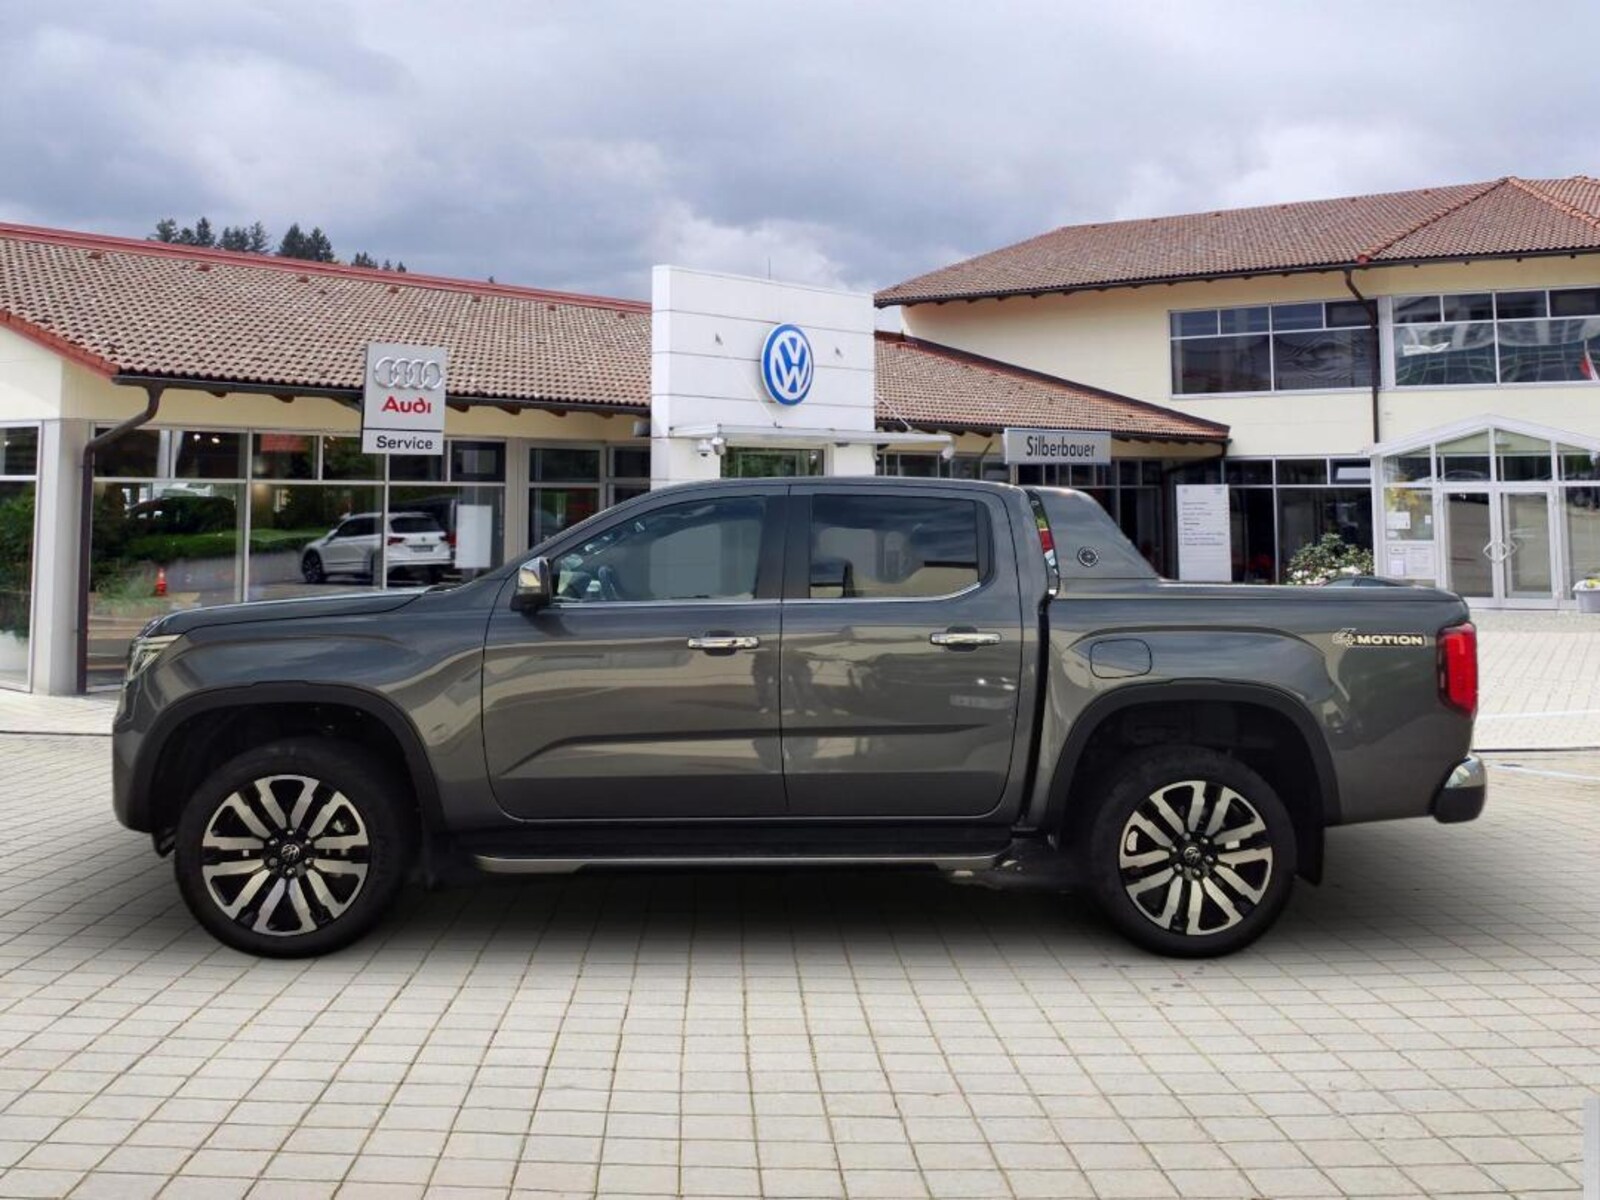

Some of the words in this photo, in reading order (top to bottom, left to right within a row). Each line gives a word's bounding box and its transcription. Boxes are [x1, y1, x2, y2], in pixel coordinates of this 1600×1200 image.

[382, 396, 432, 414] Audi
[376, 435, 433, 450] Service
[1026, 435, 1095, 457] Silberbauer
